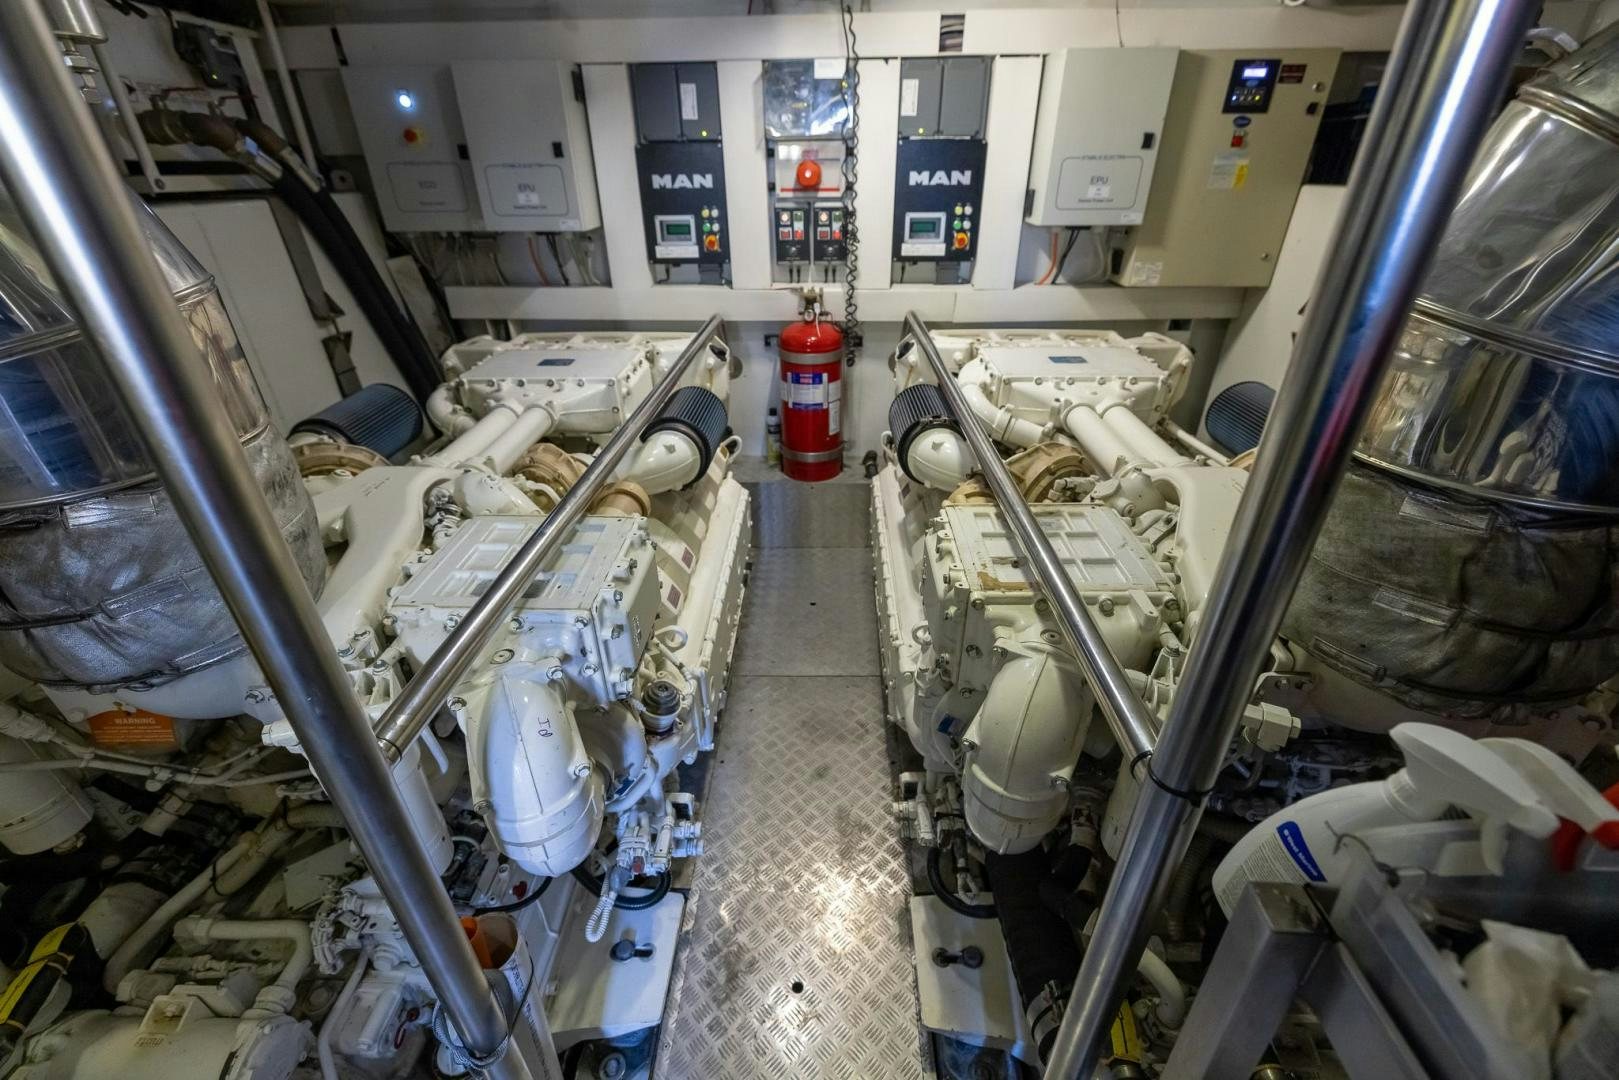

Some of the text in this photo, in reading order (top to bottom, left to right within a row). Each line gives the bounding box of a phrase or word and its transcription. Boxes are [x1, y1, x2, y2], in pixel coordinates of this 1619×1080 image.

[651, 173, 714, 189] MAN
[908, 170, 972, 187] MAN
[114, 717, 156, 725] WARNING
